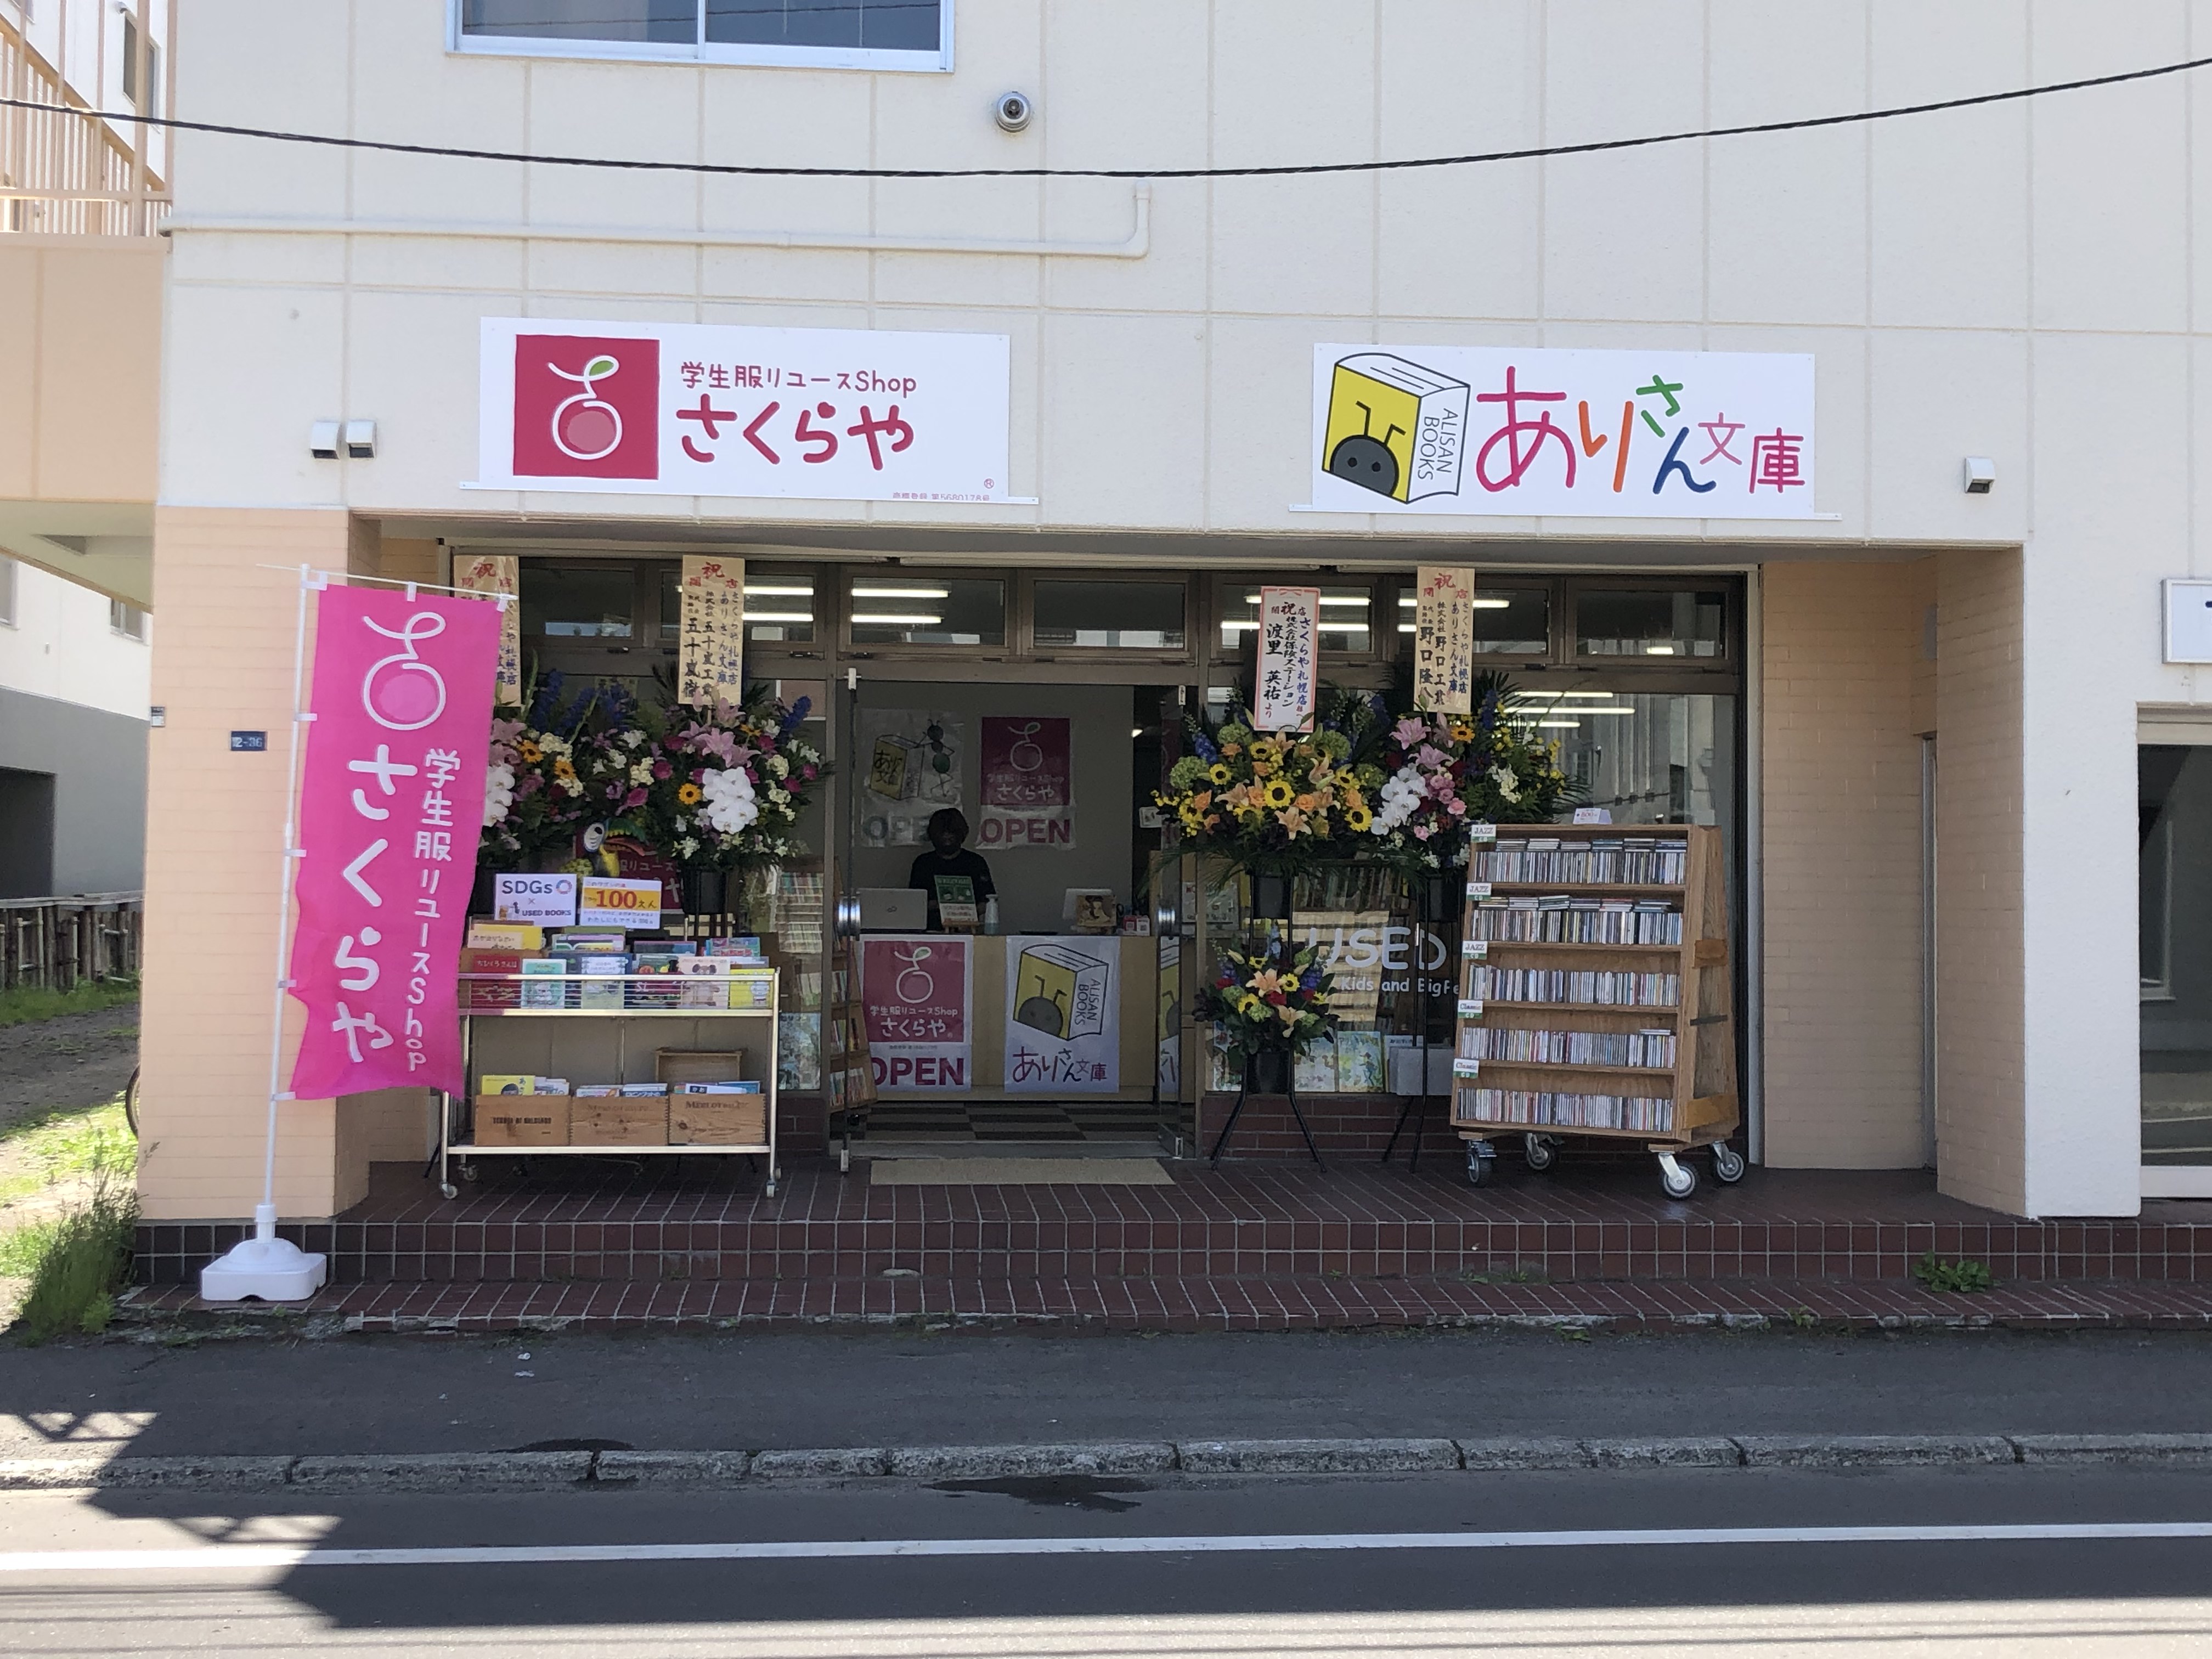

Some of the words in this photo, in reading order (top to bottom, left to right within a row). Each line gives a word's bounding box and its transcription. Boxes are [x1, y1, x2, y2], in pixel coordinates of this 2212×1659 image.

[680, 360, 917, 399] 学生服リユースShop
[675, 393, 916, 471] さくらや
[1418, 415, 1440, 482] BOOKS
[1443, 407, 1459, 474] ALISAN
[1476, 366, 1805, 493] ありさん文庫
[473, 563, 496, 578] 祝
[702, 561, 725, 579] 祝
[1434, 572, 1457, 590] 祝
[997, 783, 1056, 802] さくらや
[980, 818, 1070, 844] OPEN
[332, 744, 419, 1063] さくらや
[501, 880, 553, 895] SDGs
[404, 748, 461, 1072] 学生服リユースShop
[1307, 926, 1447, 970] USED
[1088, 978, 1102, 1021] ALISAN
[1340, 976, 1374, 991] Kids
[1381, 978, 1409, 992] and
[870, 1005, 958, 1017] 学生服リユースShop
[1074, 984, 1088, 1025] BOOKS
[880, 1017, 946, 1037] さくらや
